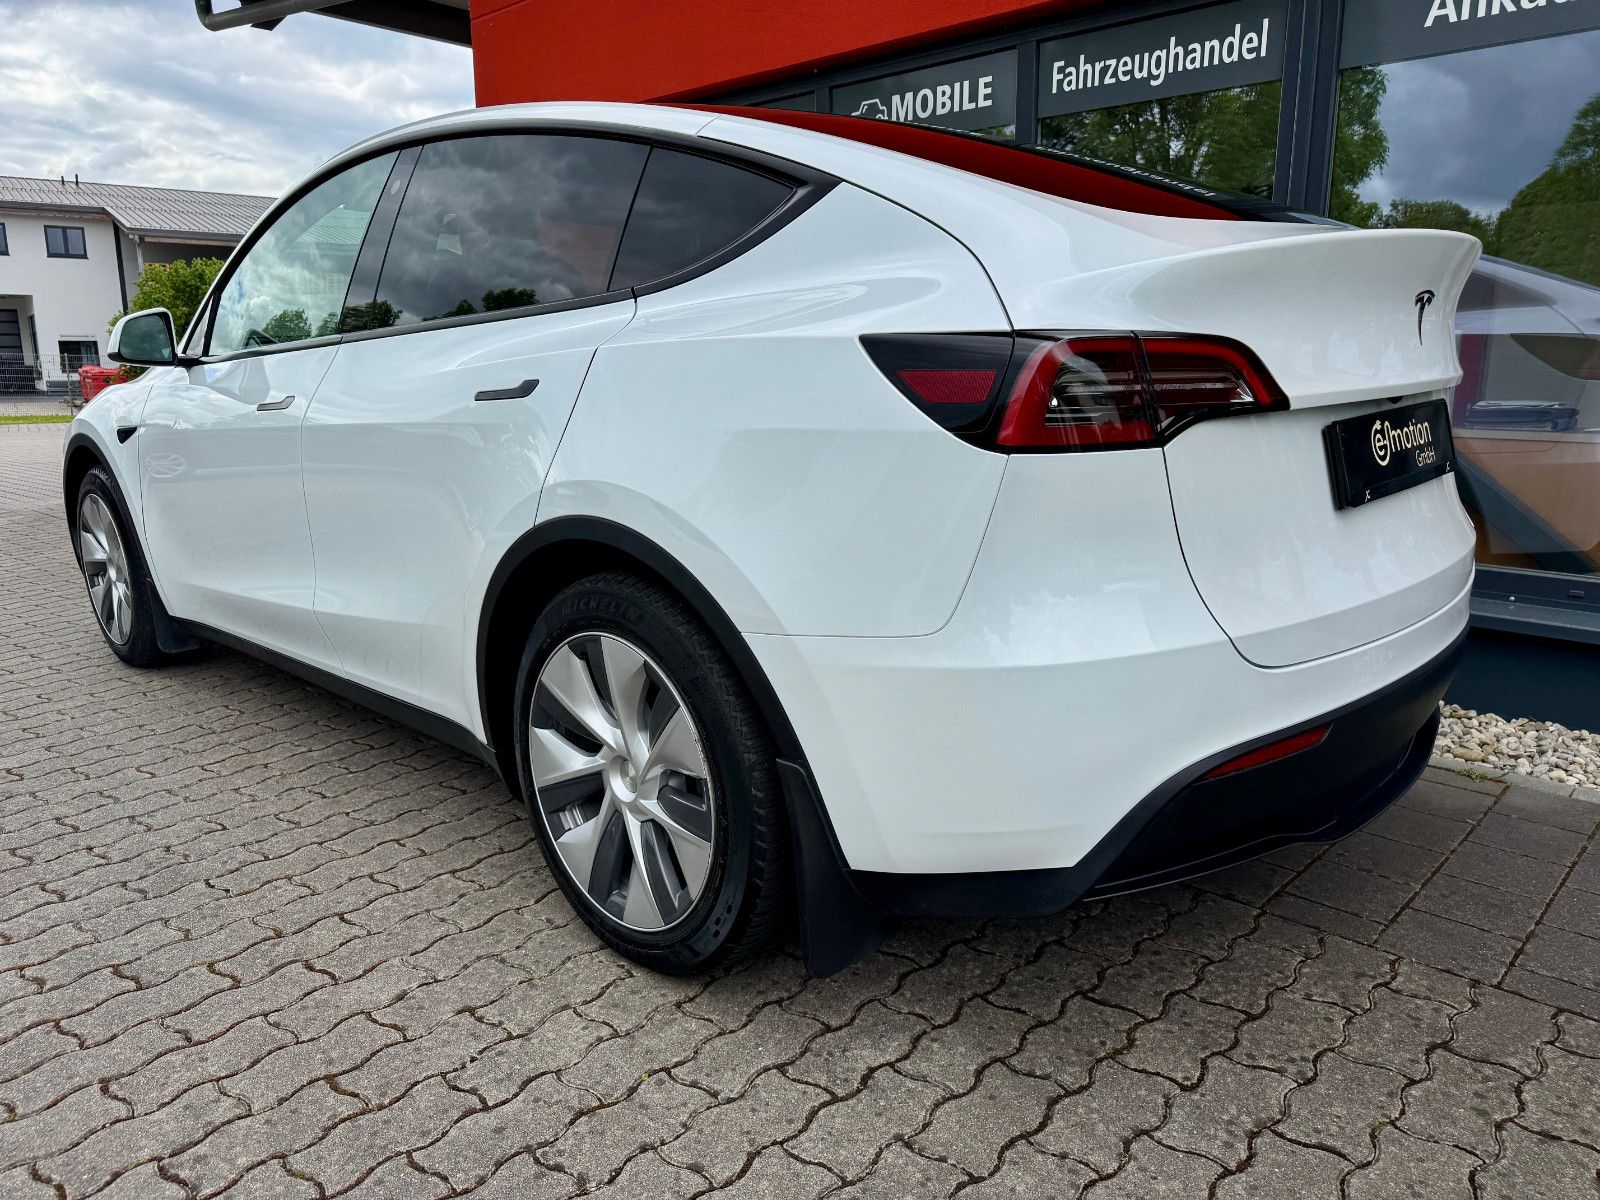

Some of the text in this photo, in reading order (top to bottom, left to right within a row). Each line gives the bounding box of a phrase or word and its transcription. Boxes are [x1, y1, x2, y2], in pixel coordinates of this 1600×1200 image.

[1052, 18, 1269, 94] Fahrzeughandel
[891, 75, 993, 122] MOBILE
[1415, 446, 1436, 467] GmbH
